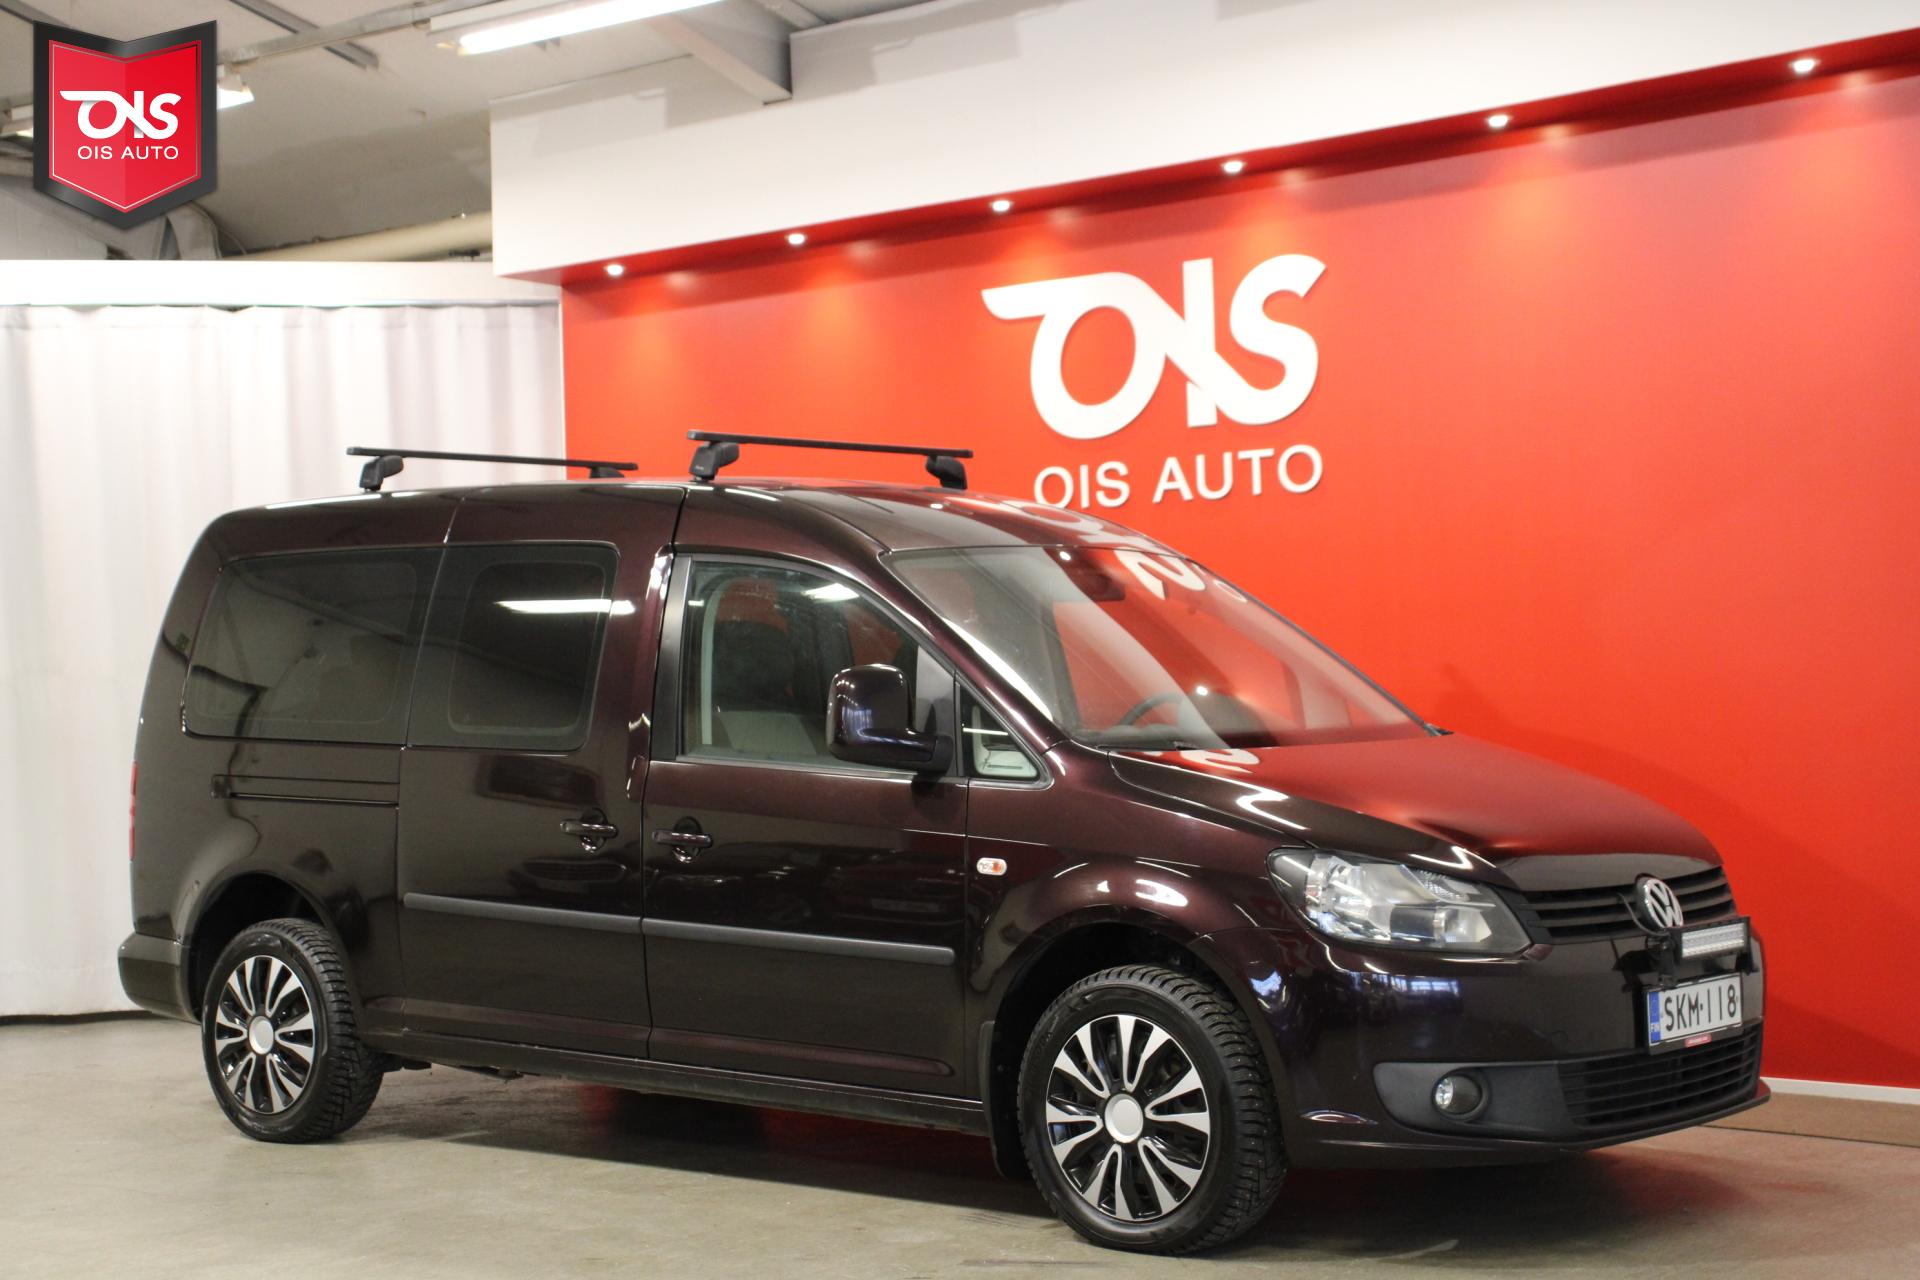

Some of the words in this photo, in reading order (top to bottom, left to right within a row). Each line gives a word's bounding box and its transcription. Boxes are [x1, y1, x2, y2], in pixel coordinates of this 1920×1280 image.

[981, 254, 1327, 440] OIS
[1033, 460, 1131, 509] OIS
[1152, 444, 1323, 503] AUTO
[1664, 984, 1738, 1032] SKM-118
